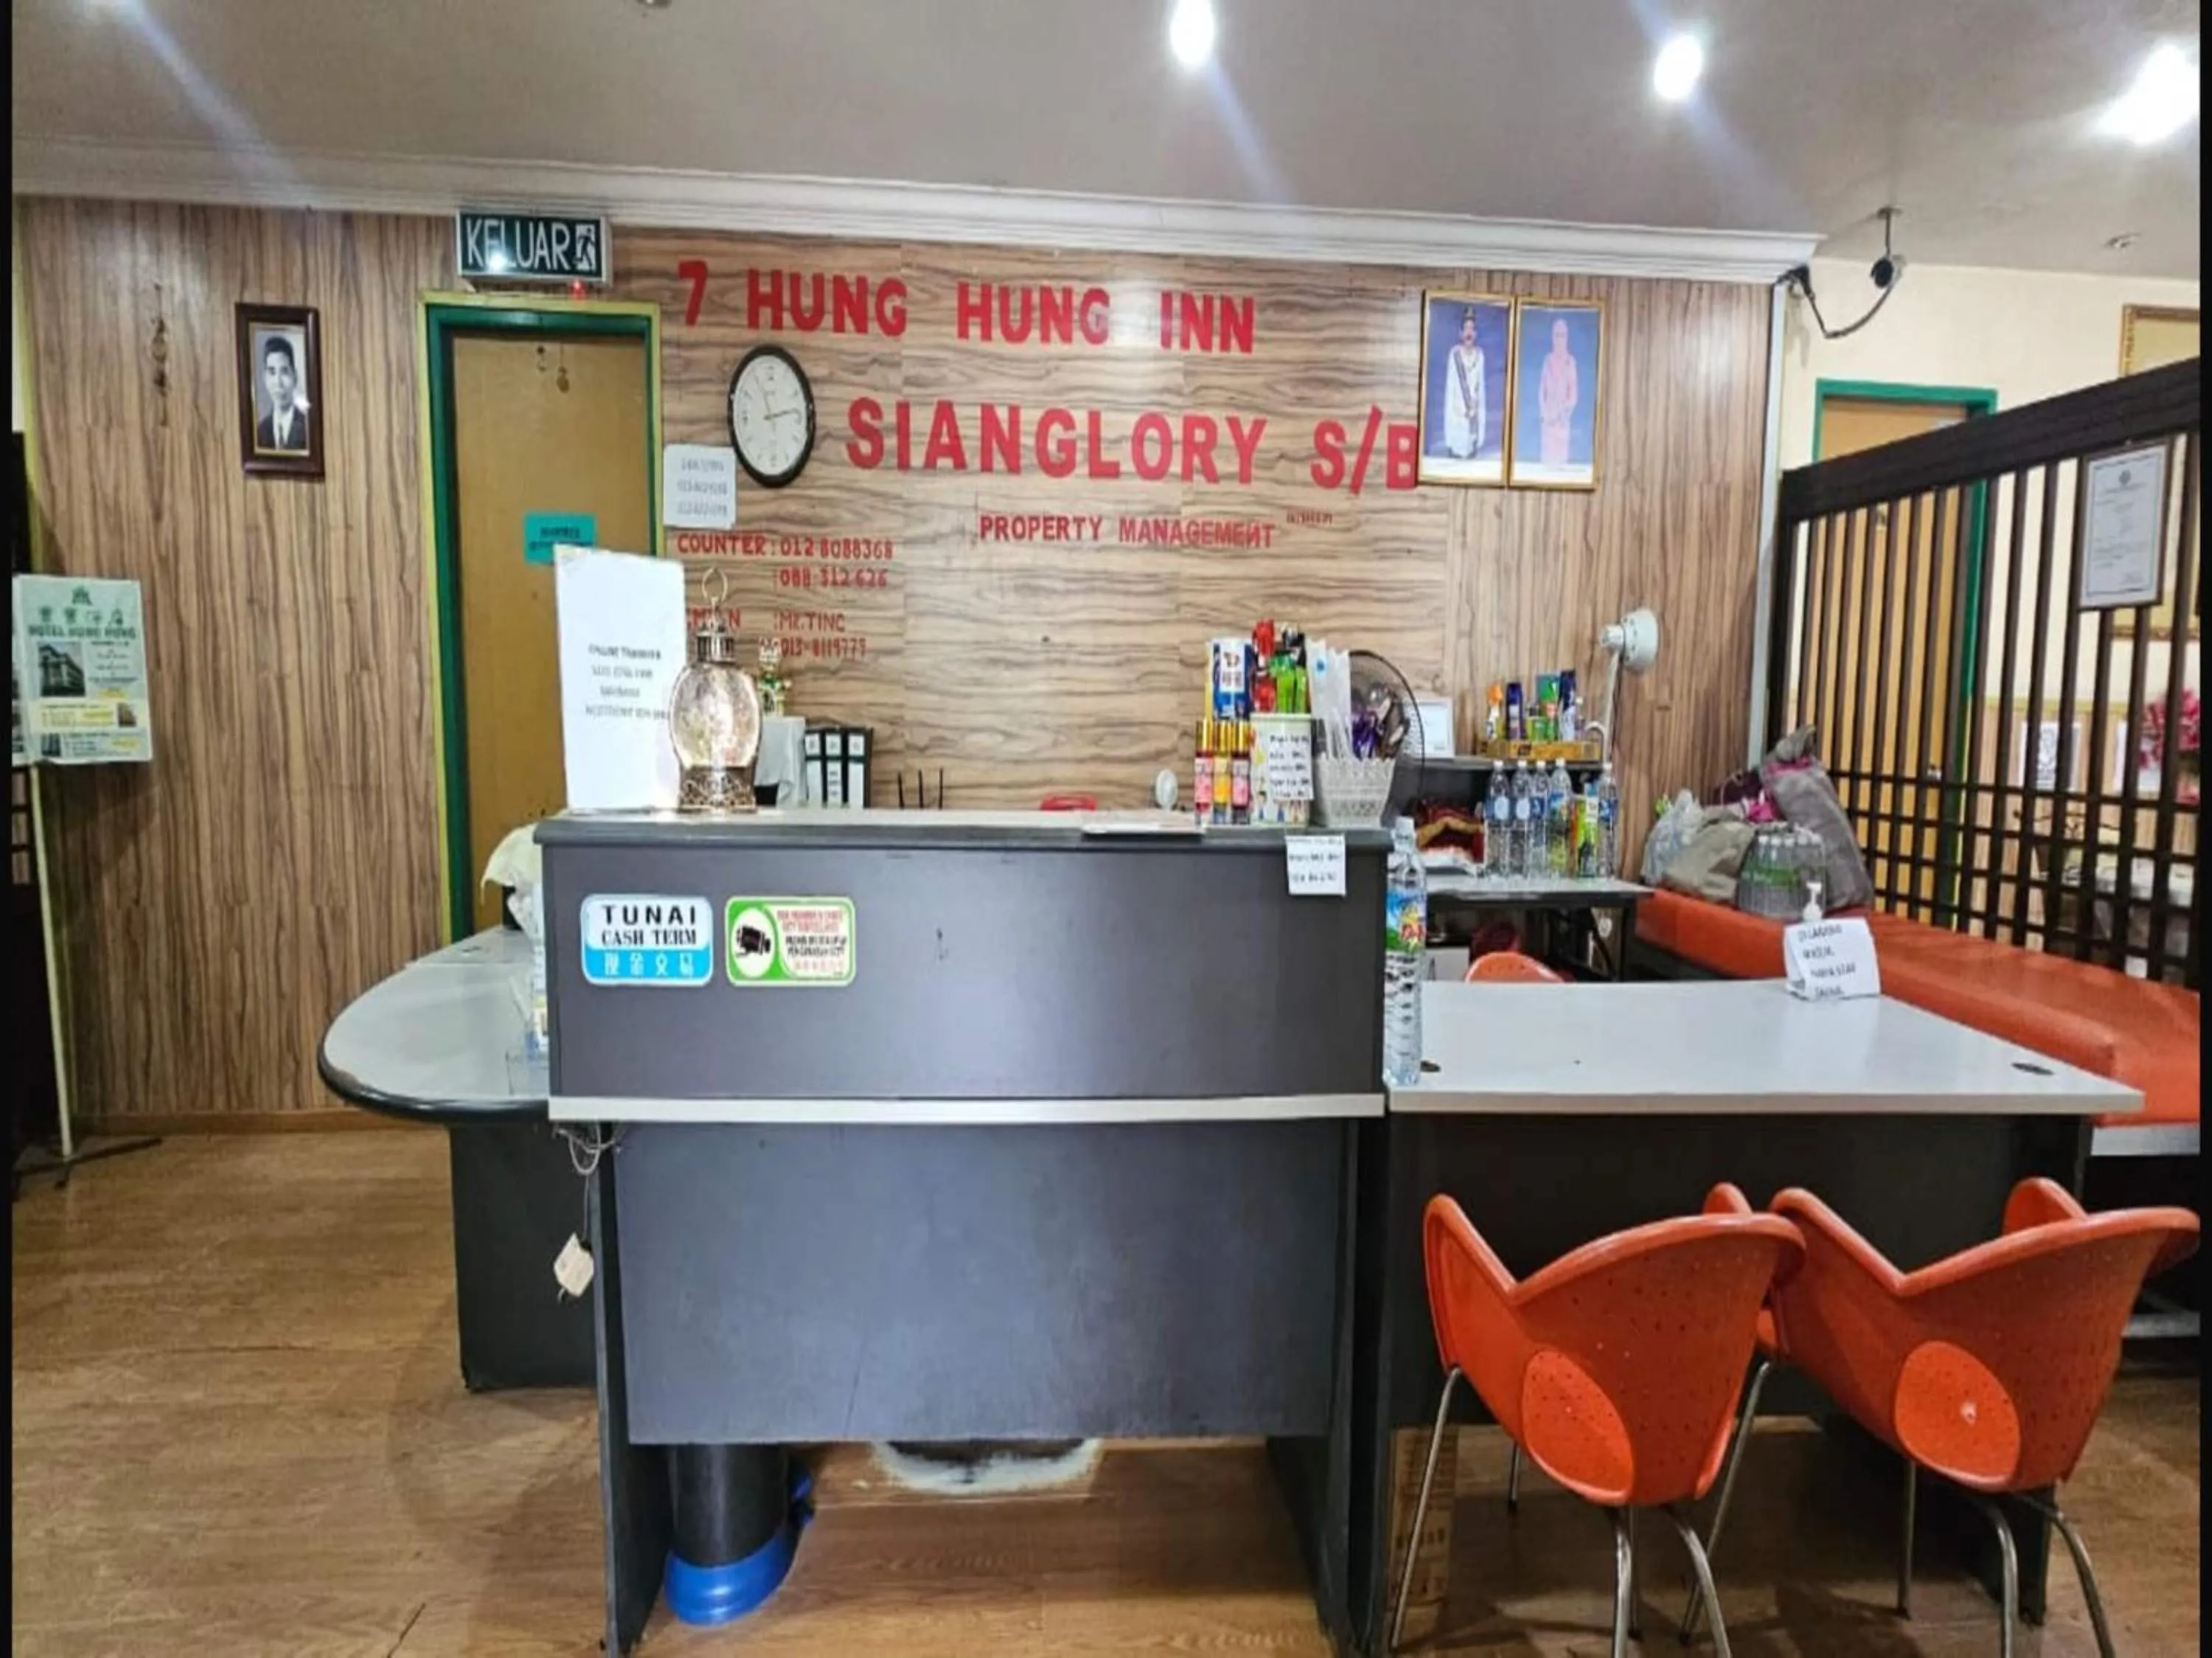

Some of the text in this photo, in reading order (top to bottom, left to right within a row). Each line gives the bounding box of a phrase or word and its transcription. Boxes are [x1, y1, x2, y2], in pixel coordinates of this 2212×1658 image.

[466, 218, 570, 271] KELUAR
[678, 259, 1255, 354] 7 HUNG HUNG INN
[846, 397, 1268, 485] SIANGLORY
[780, 535, 814, 557] 012
[978, 514, 1103, 542] PROPERTY
[1118, 516, 1275, 549] MANAGEMENT
[602, 905, 696, 926] TUNAI
[602, 929, 697, 946] CASH TERM
